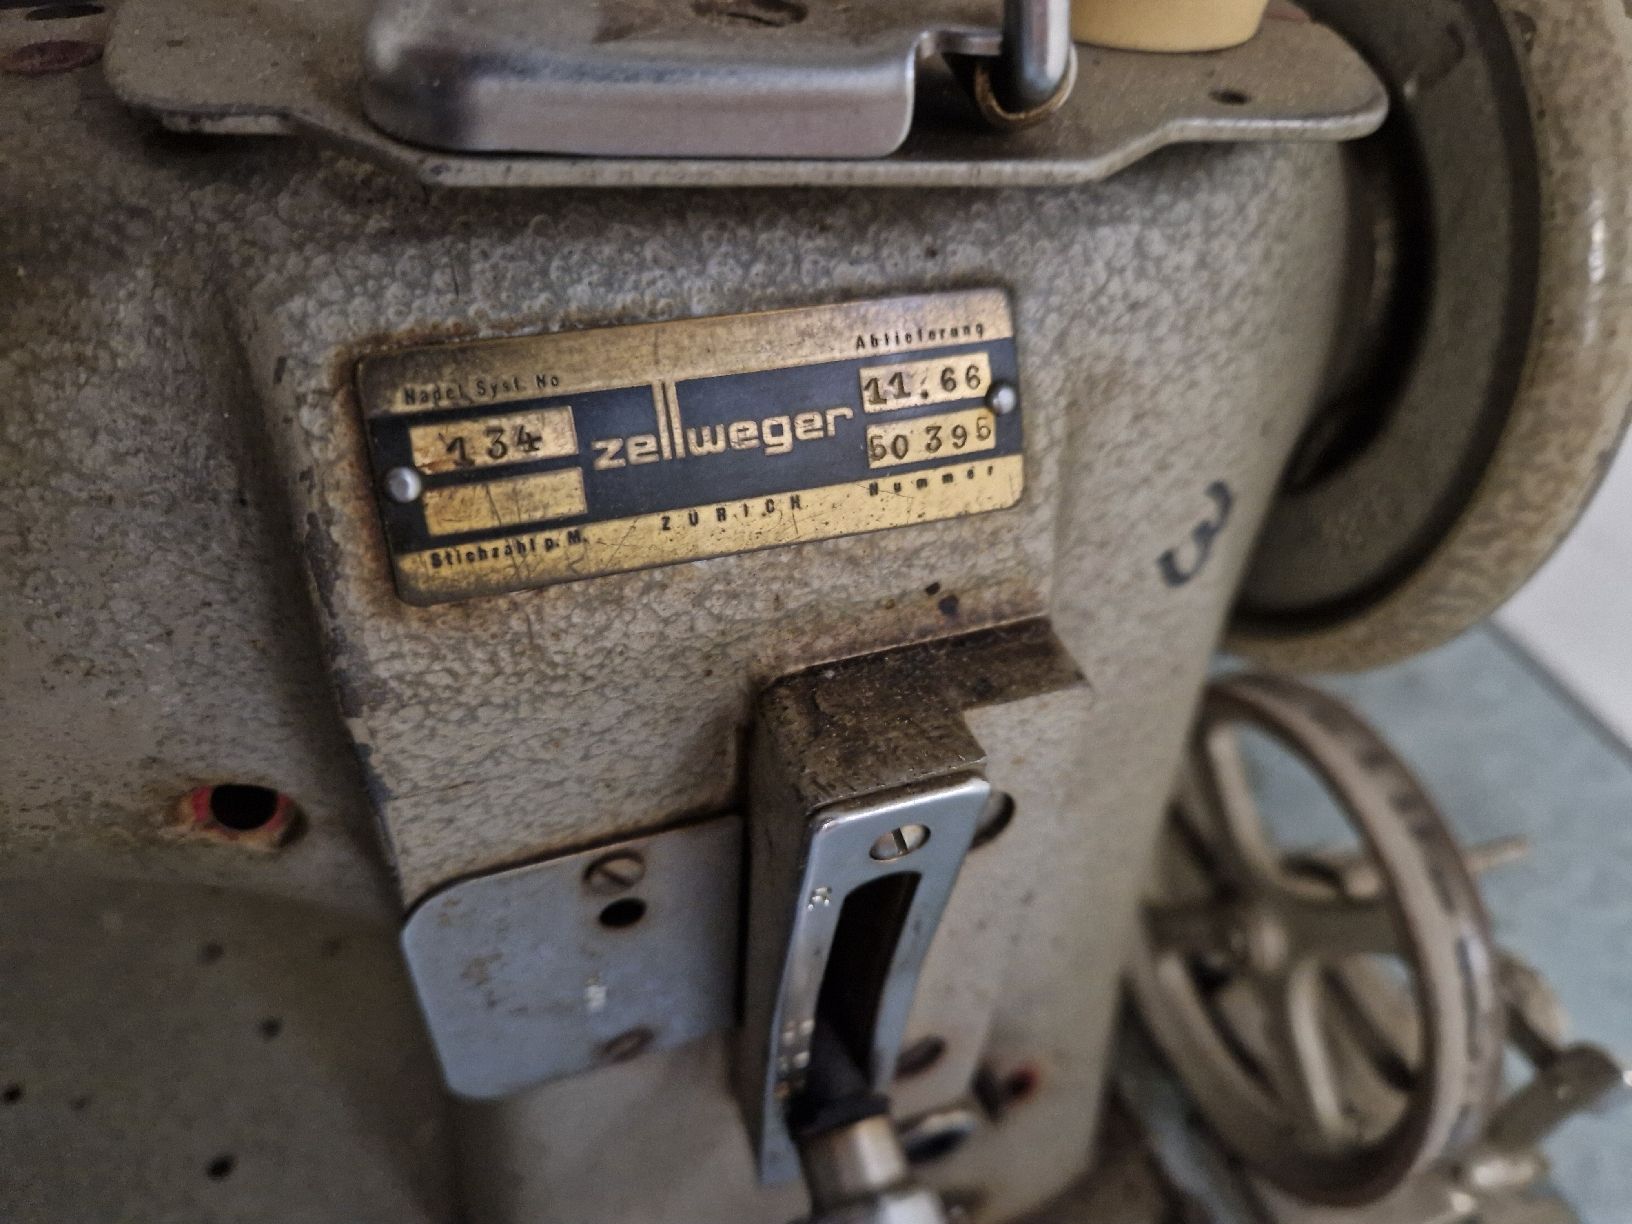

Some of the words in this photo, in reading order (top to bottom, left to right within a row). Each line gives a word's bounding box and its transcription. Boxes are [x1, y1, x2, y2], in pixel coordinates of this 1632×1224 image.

[446, 424, 544, 467] 134
[591, 378, 854, 472] zellweger
[868, 465, 994, 498] Nummer
